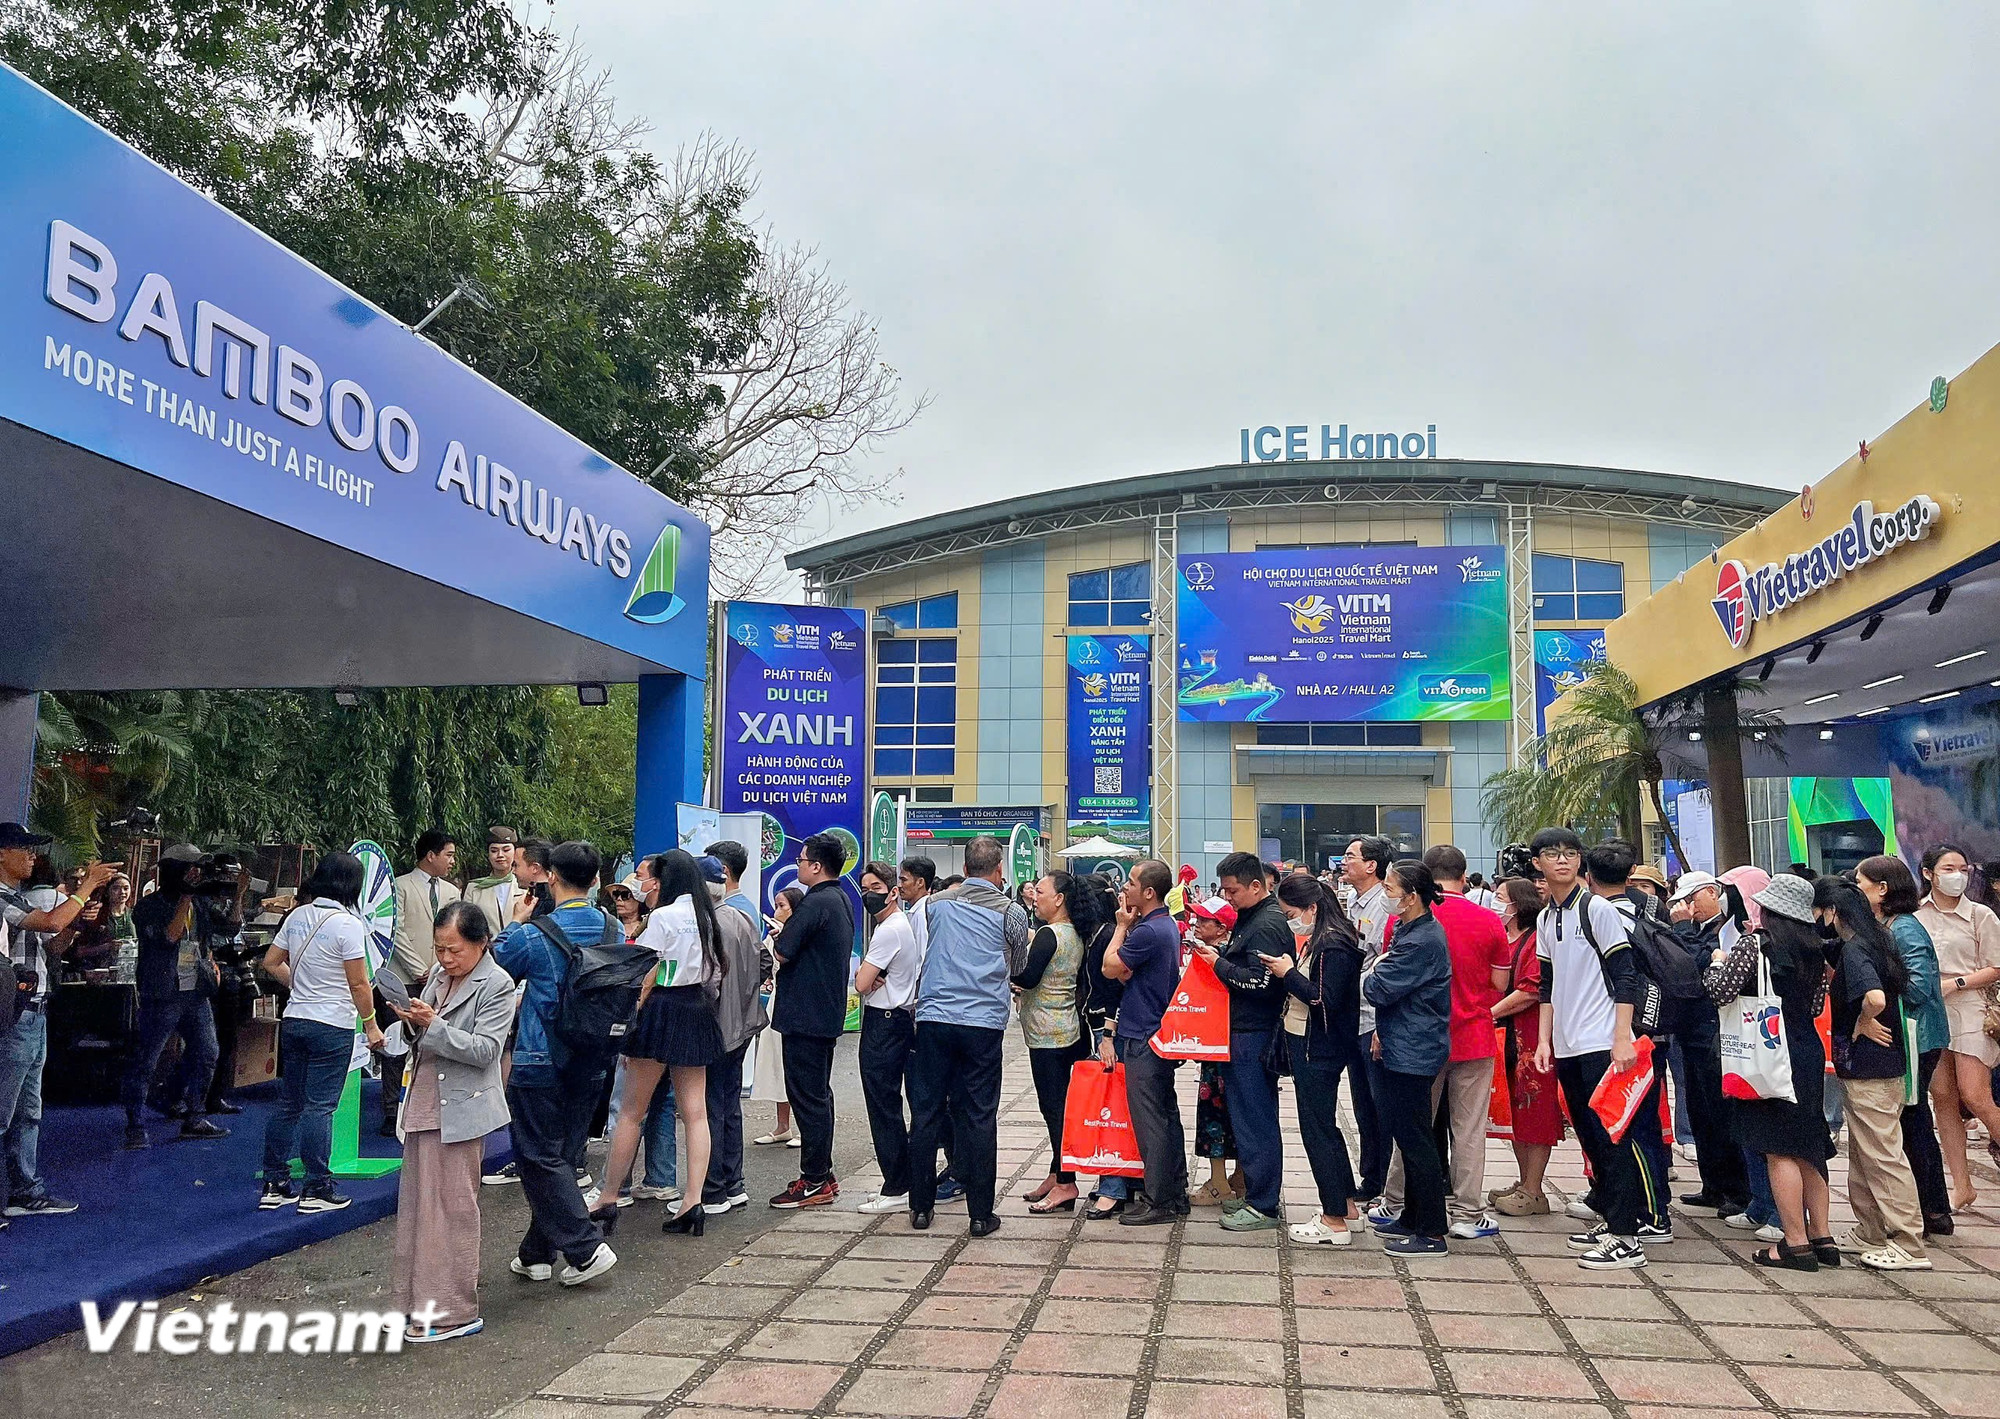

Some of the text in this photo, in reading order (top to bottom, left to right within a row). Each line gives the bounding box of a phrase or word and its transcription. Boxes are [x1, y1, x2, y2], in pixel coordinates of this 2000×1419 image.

[46, 219, 632, 579] BAMBOO AIRWAYS
[44, 335, 376, 508] MORE THAN JUST A FLIGHT
[1241, 424, 1437, 462] ICE Hanoi
[1744, 497, 1930, 621] Vietravel corp.
[1243, 562, 1438, 582] HỘI CHỢ DU LỊCH QUỐC TẾ VIỆT NAM
[1456, 564, 1501, 583] Vietnam
[1268, 577, 1412, 588] VIETNAM INTERNATIONAL TRAVEL MART
[1337, 593, 1391, 613] VITM
[1340, 614, 1391, 625] Vietnam
[795, 624, 820, 636] VITM
[1340, 625, 1391, 634] International
[795, 634, 820, 642] Vietnam
[1339, 634, 1391, 643] Travel Mart
[763, 666, 832, 682] PHÁT TRIỂN
[1109, 672, 1140, 685] VITM
[1110, 684, 1140, 692] Vietnam
[1296, 683, 1321, 696] NHÀ
[1323, 685, 1339, 696] A2
[1350, 685, 1376, 695] HALL
[1379, 685, 1395, 695] A2
[767, 687, 828, 705] DU LỊCH
[737, 711, 853, 746] XANH
[1089, 726, 1127, 737] XANH
[1106, 748, 1120, 757] LỊCH
[747, 753, 844, 771] HÀNH ĐỘNG CỦA
[1092, 757, 1108, 765] VIỆT
[738, 771, 852, 788] CÁC DOANH NGHIỆP
[742, 789, 847, 806] DU LỊCH VIỆT NAM
[960, 810, 972, 818] BAN
[1166, 1005, 1207, 1013] stPrice Travel
[1642, 983, 1659, 1027] FASHION
[1083, 1118, 1128, 1129] BestPrice Travel
